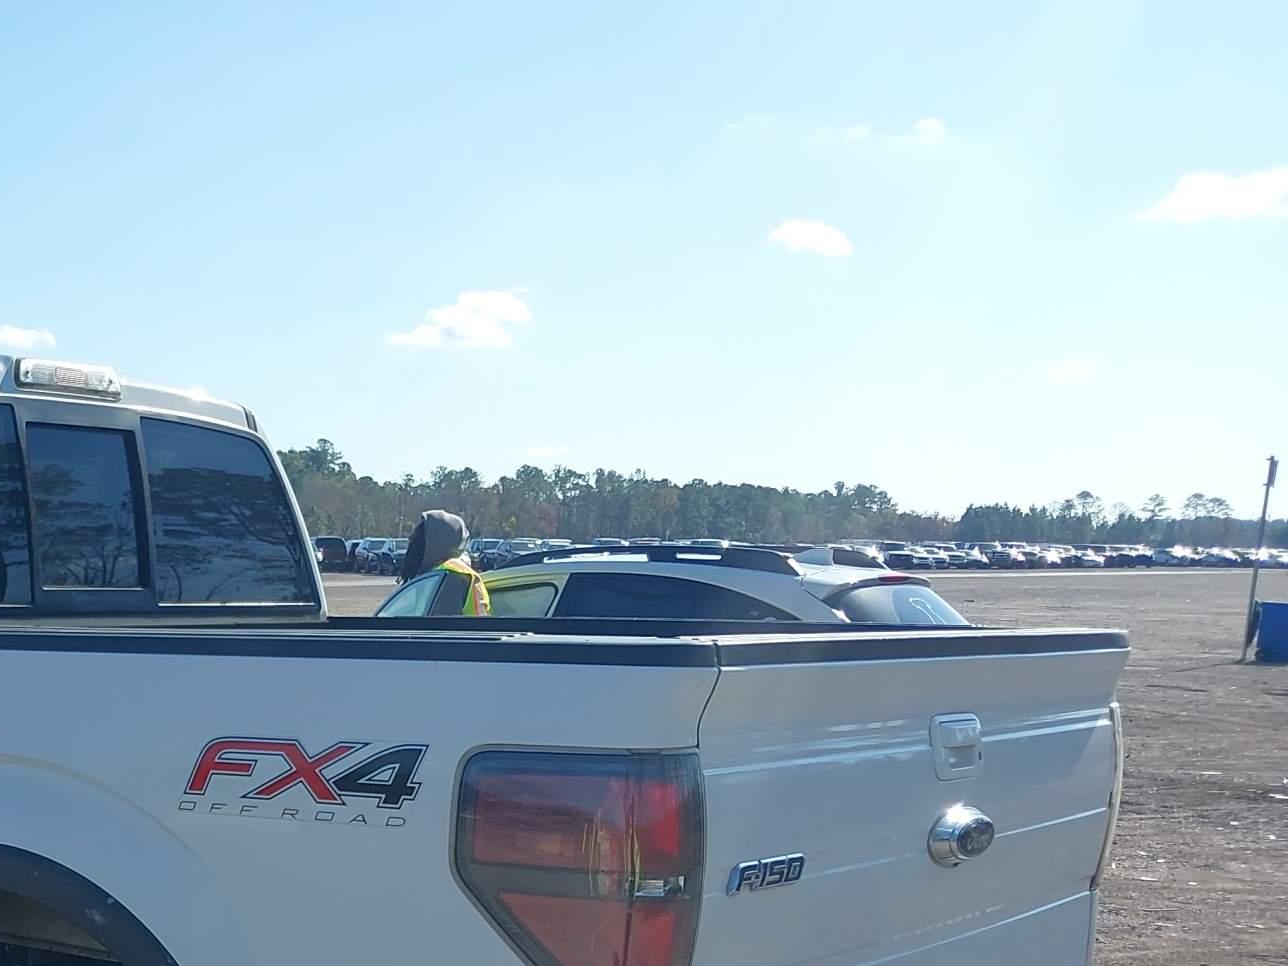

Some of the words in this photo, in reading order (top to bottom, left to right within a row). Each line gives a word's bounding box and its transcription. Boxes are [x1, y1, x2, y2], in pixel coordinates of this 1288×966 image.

[184, 736, 430, 810] FX4
[177, 799, 259, 817] OFF
[280, 807, 407, 828] ROAD
